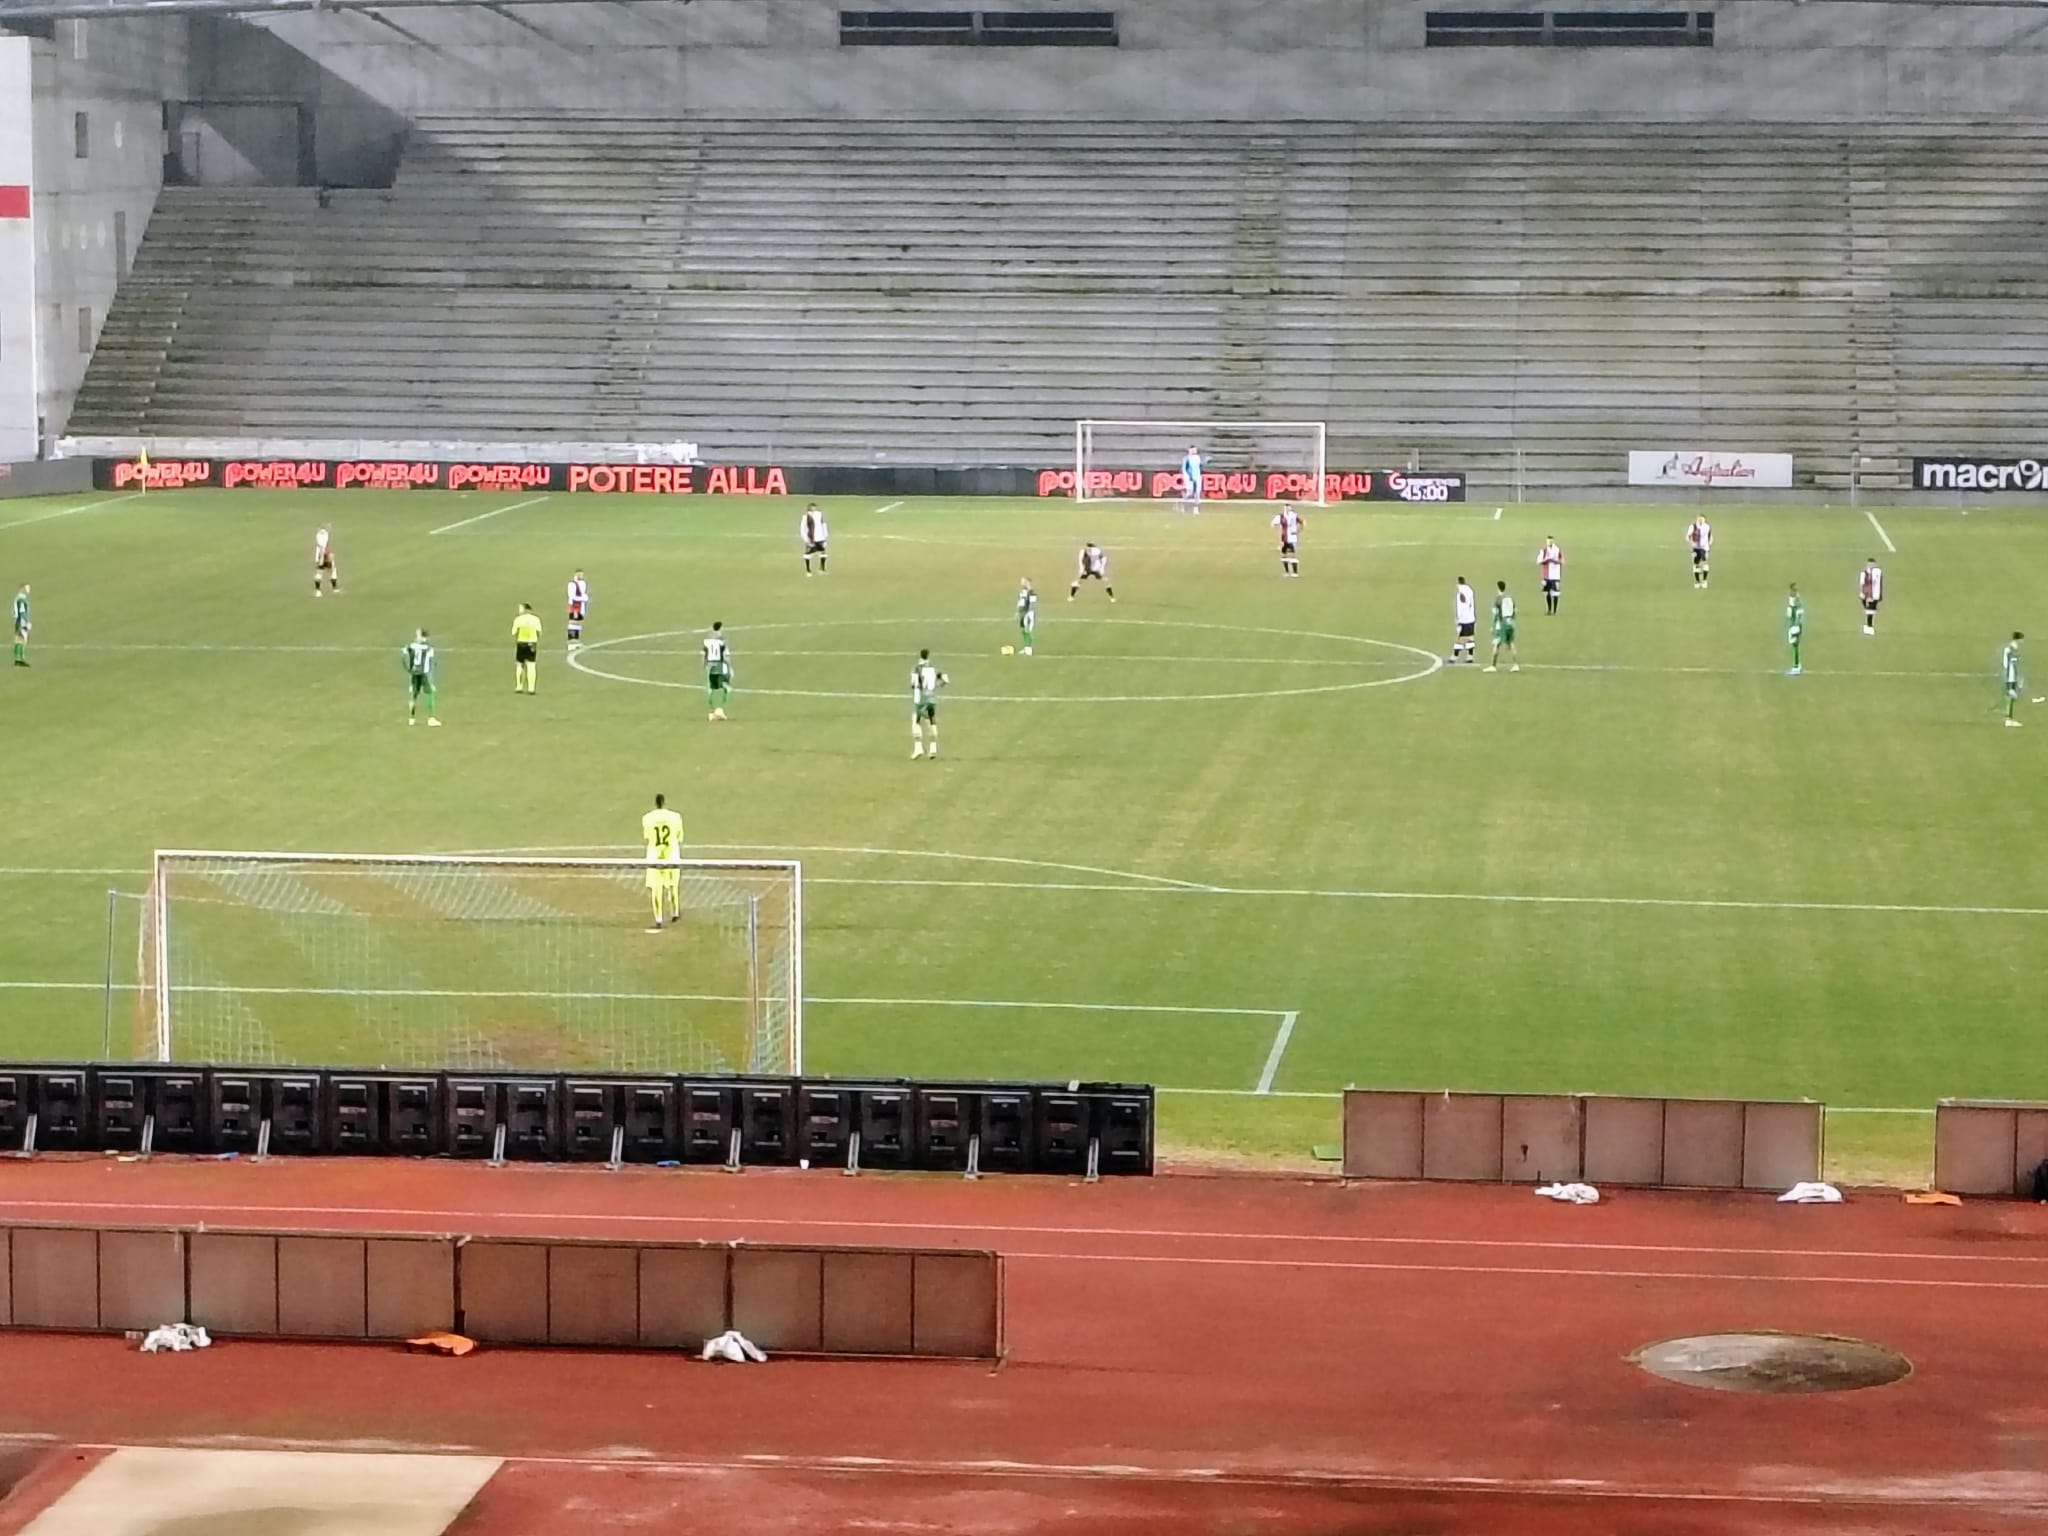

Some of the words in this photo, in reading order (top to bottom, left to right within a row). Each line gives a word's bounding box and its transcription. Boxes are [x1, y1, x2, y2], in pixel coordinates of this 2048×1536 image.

[225, 463, 325, 488] POWER4U
[336, 463, 439, 488] POWER4U
[449, 464, 550, 490] POWER4U
[570, 466, 692, 493] POTERE
[706, 466, 787, 494] ALLA
[1152, 472, 1256, 497] POER4U
[654, 825, 671, 847] 12
